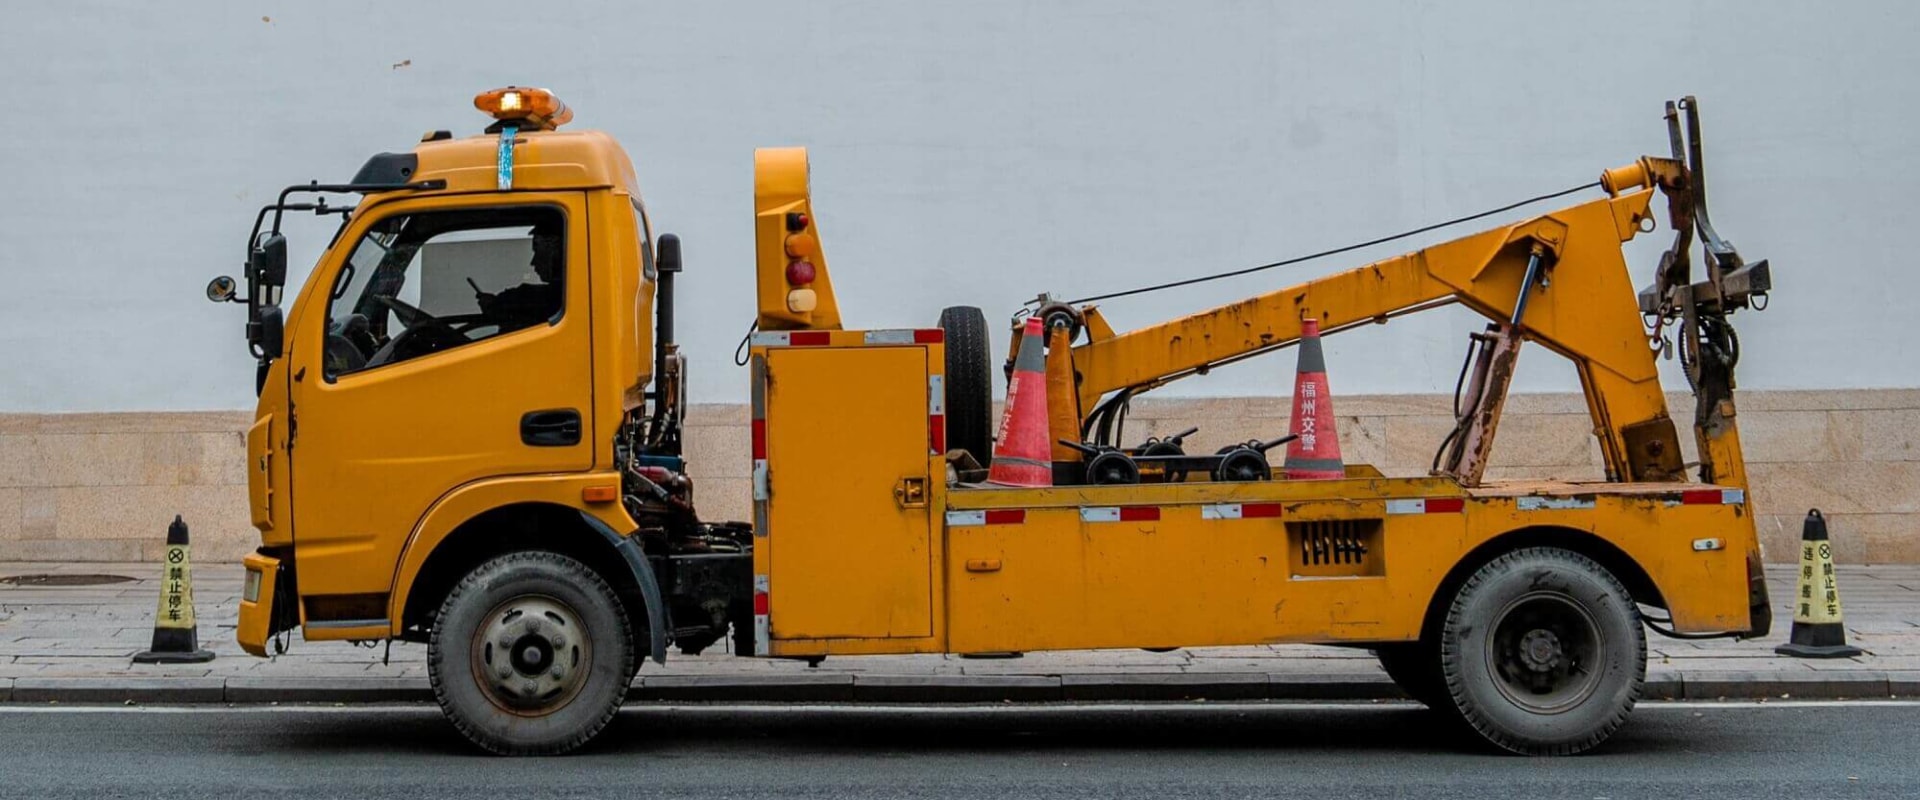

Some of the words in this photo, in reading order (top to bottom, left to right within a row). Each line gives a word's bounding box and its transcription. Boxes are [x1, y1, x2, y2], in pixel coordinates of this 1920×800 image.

[1301, 381, 1316, 451] 福州交警
[168, 567, 182, 622] 禁止停车
[1823, 562, 1837, 616] 禁止停车
